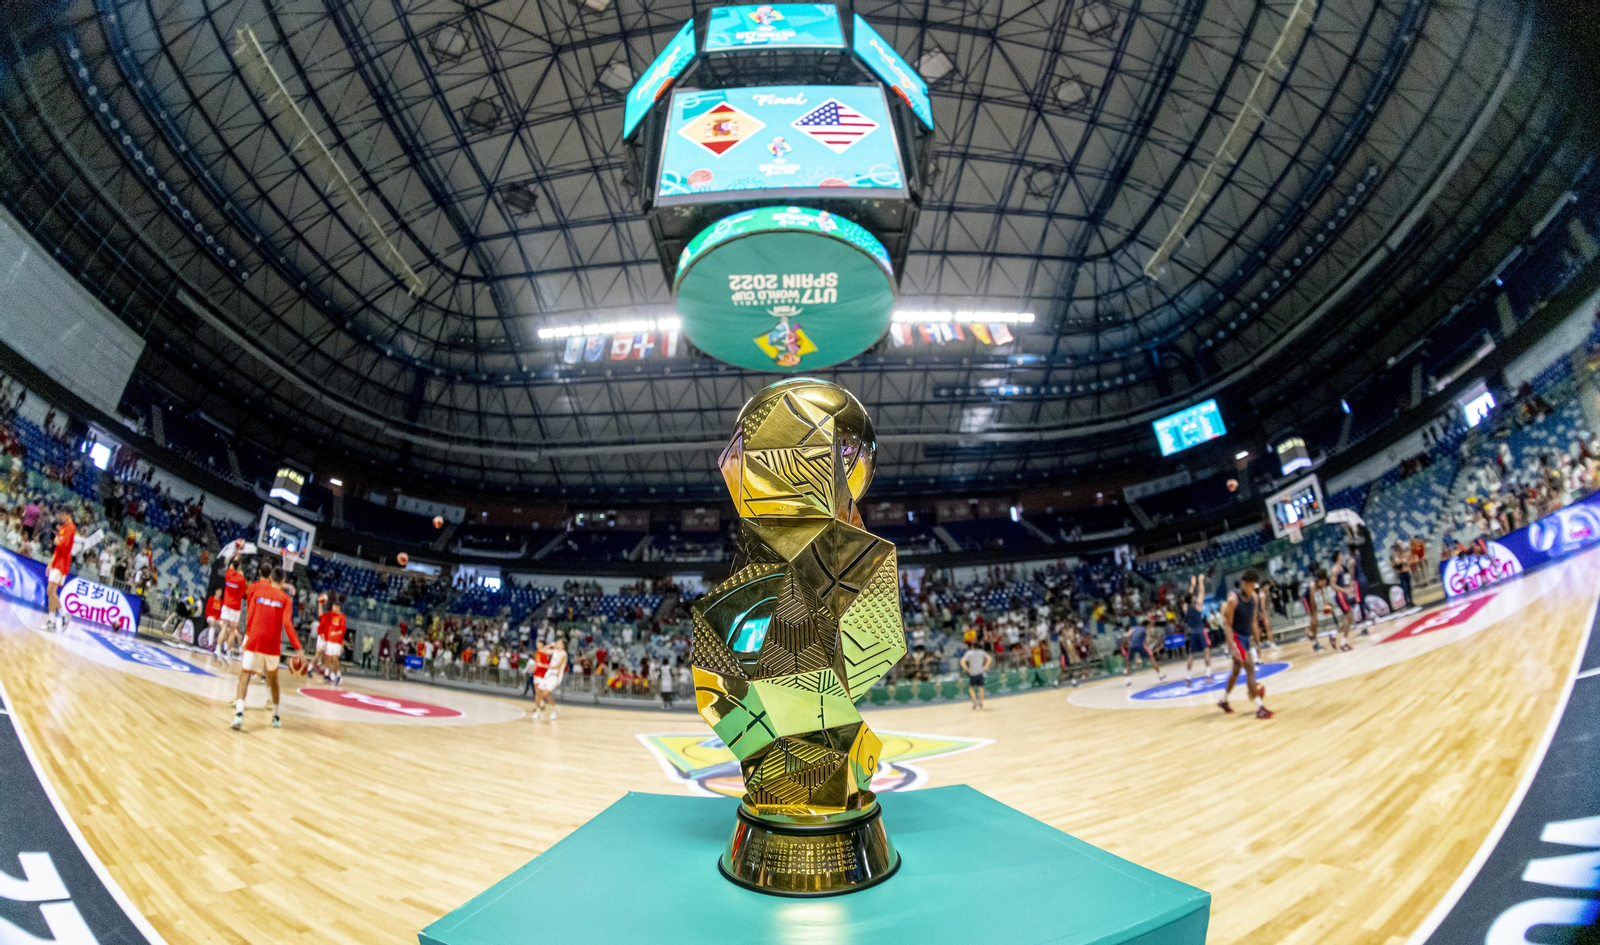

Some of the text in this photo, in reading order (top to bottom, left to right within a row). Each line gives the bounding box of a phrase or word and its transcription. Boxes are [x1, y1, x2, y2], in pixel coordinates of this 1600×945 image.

[752, 92, 808, 107] Final
[728, 272, 839, 291] SPAIN 2022
[731, 287, 838, 304] U17 WORLD CUP
[76, 578, 120, 606] 百岁山
[64, 592, 131, 631] Ganten
[826, 840, 854, 848] AMERICA
[765, 846, 788, 855] UNITED
[826, 846, 855, 854] AMERICA
[764, 852, 787, 862] UNITED
[826, 852, 856, 861] AMERICA
[828, 858, 858, 867] AMERICA
[828, 864, 858, 873] AMERICA
